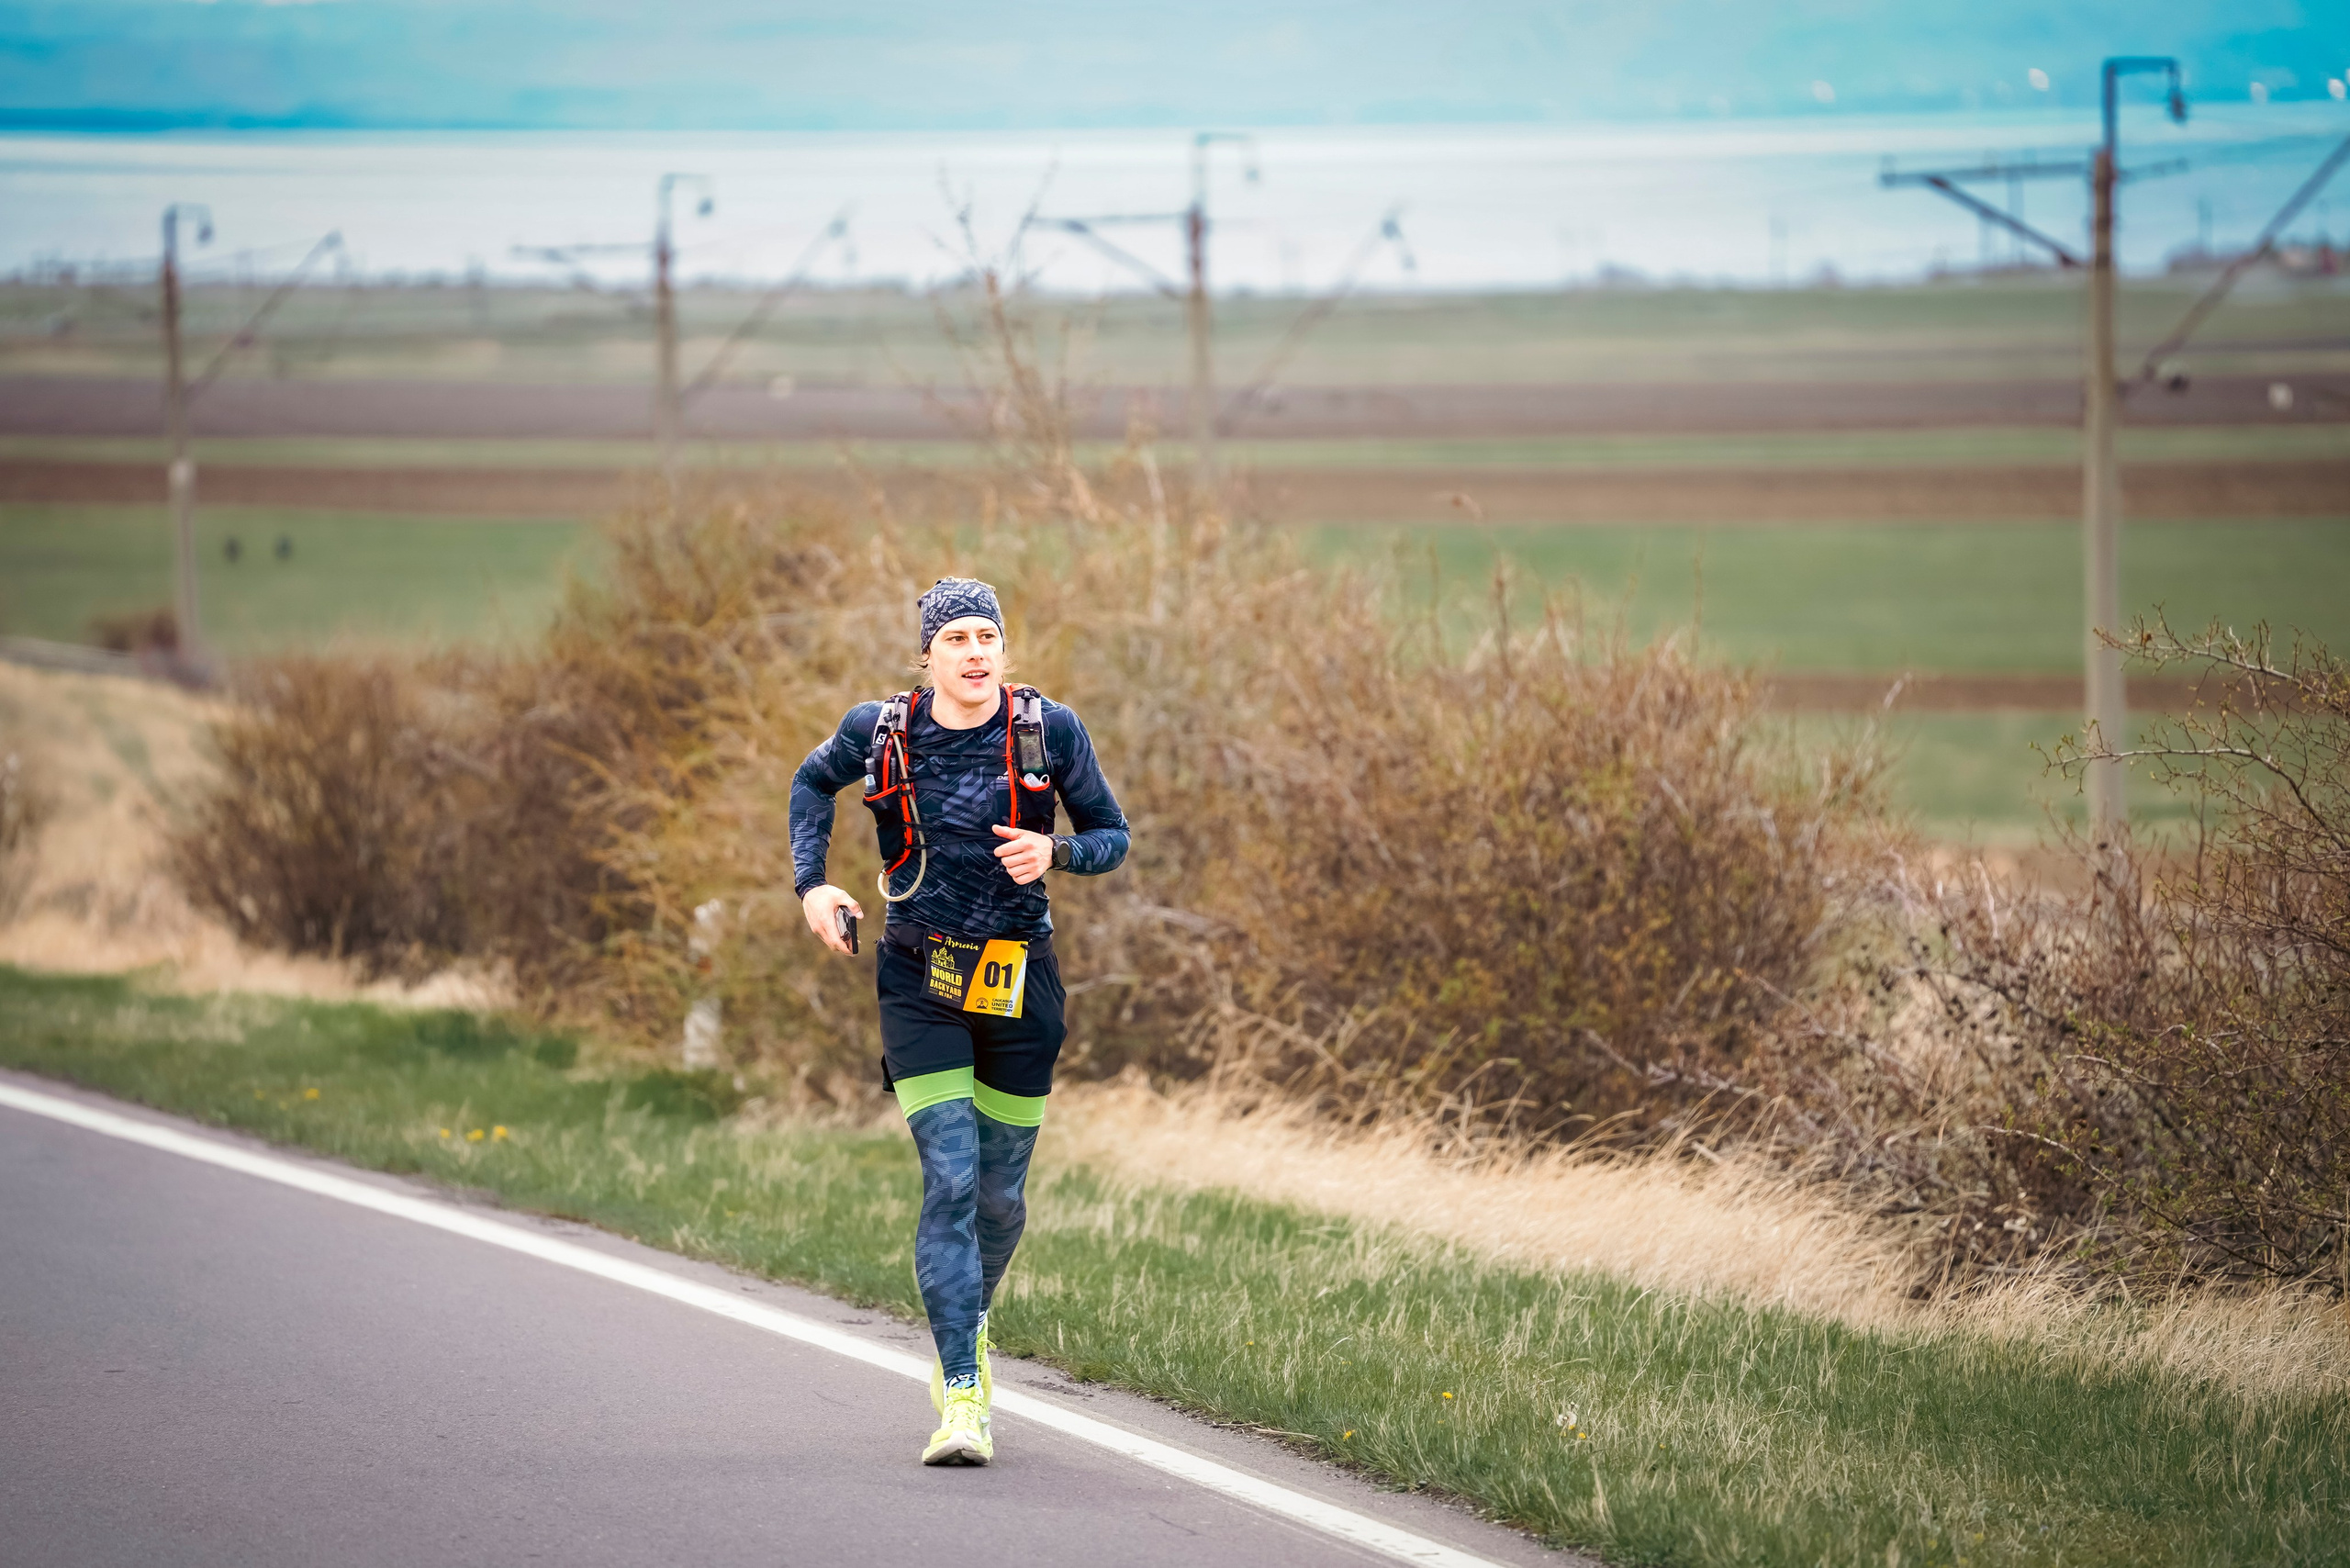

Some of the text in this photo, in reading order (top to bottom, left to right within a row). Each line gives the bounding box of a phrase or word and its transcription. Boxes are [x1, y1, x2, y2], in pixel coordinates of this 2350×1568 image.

[947, 604, 966, 615] Mostar
[978, 599, 992, 610] Town
[931, 965, 963, 987] WORLD
[983, 960, 1013, 990] 01
[929, 979, 962, 997] BACKYARD
[938, 991, 953, 1000] ULTRA
